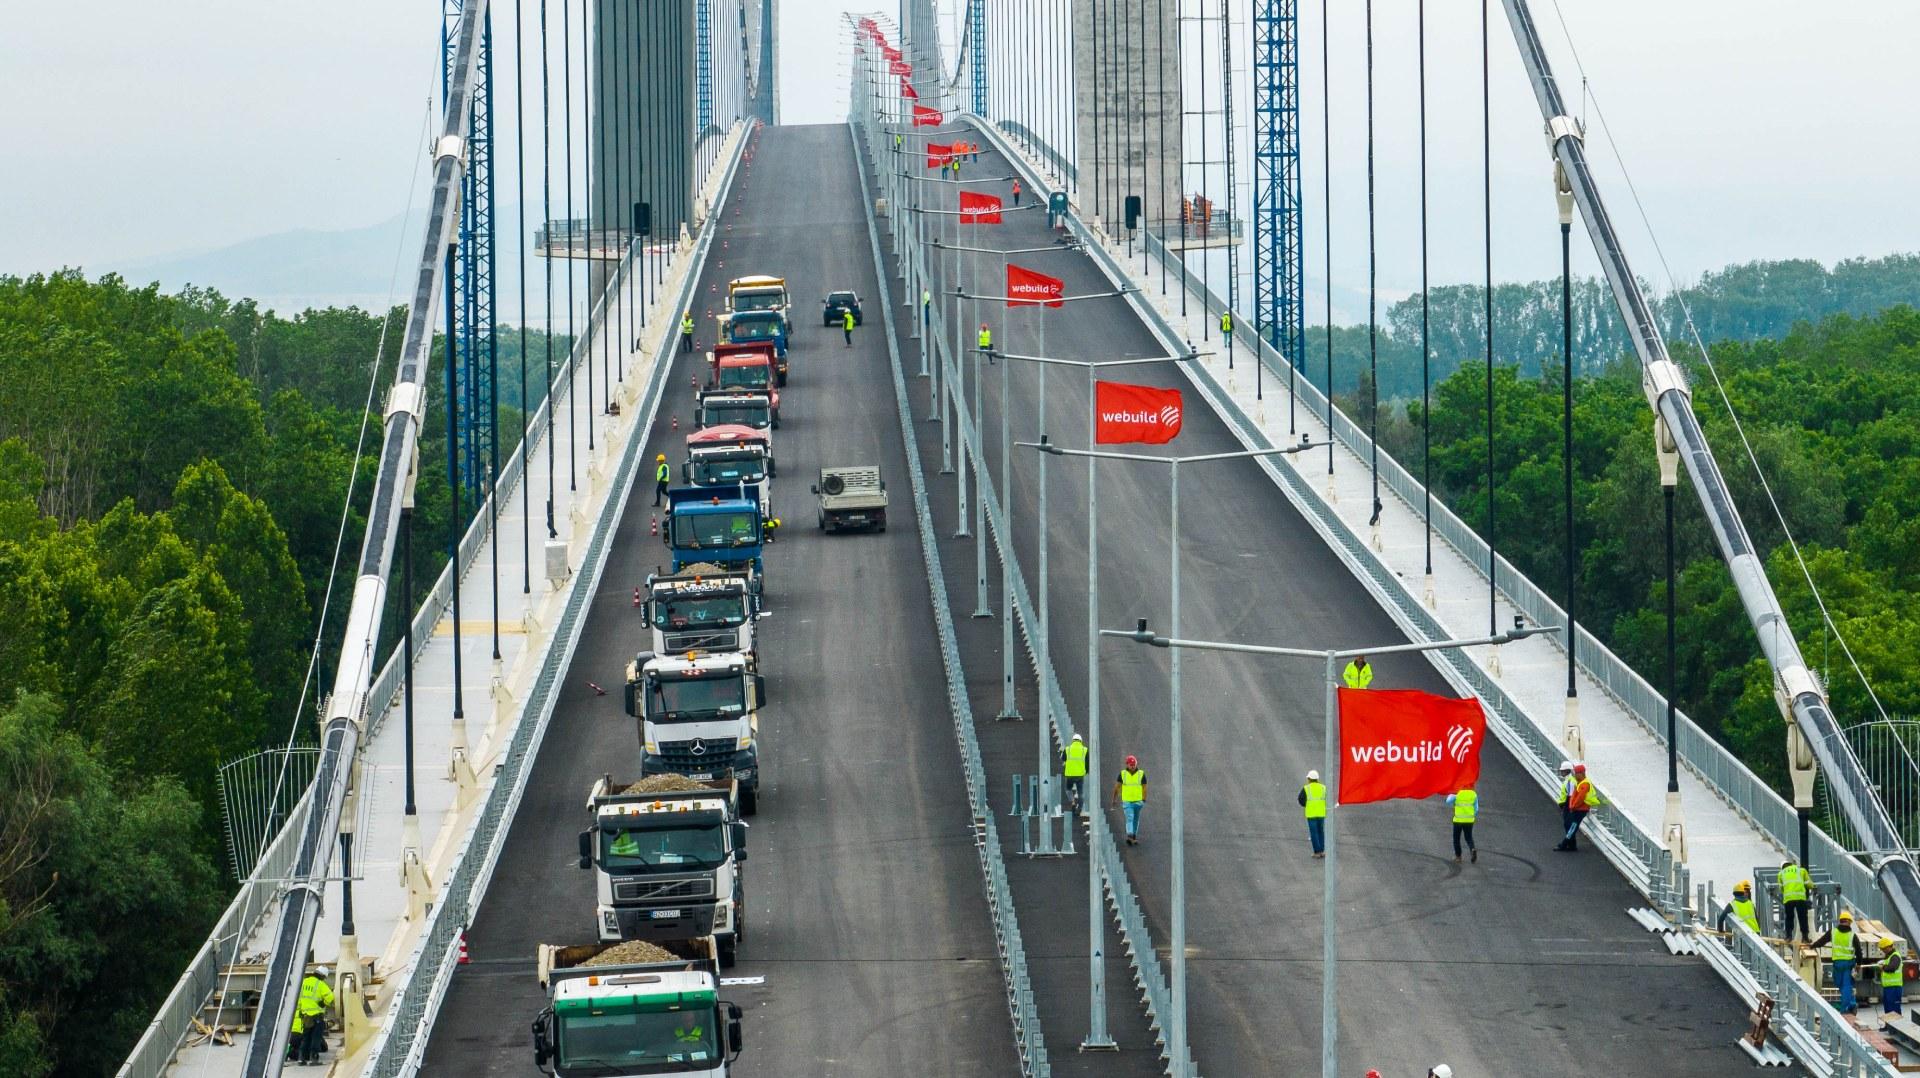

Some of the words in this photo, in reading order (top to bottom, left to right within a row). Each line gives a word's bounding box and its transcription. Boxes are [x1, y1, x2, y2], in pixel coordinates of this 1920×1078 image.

[1012, 283, 1049, 293] webuild
[1102, 410, 1158, 424] webuild
[1351, 740, 1443, 763] webuild
